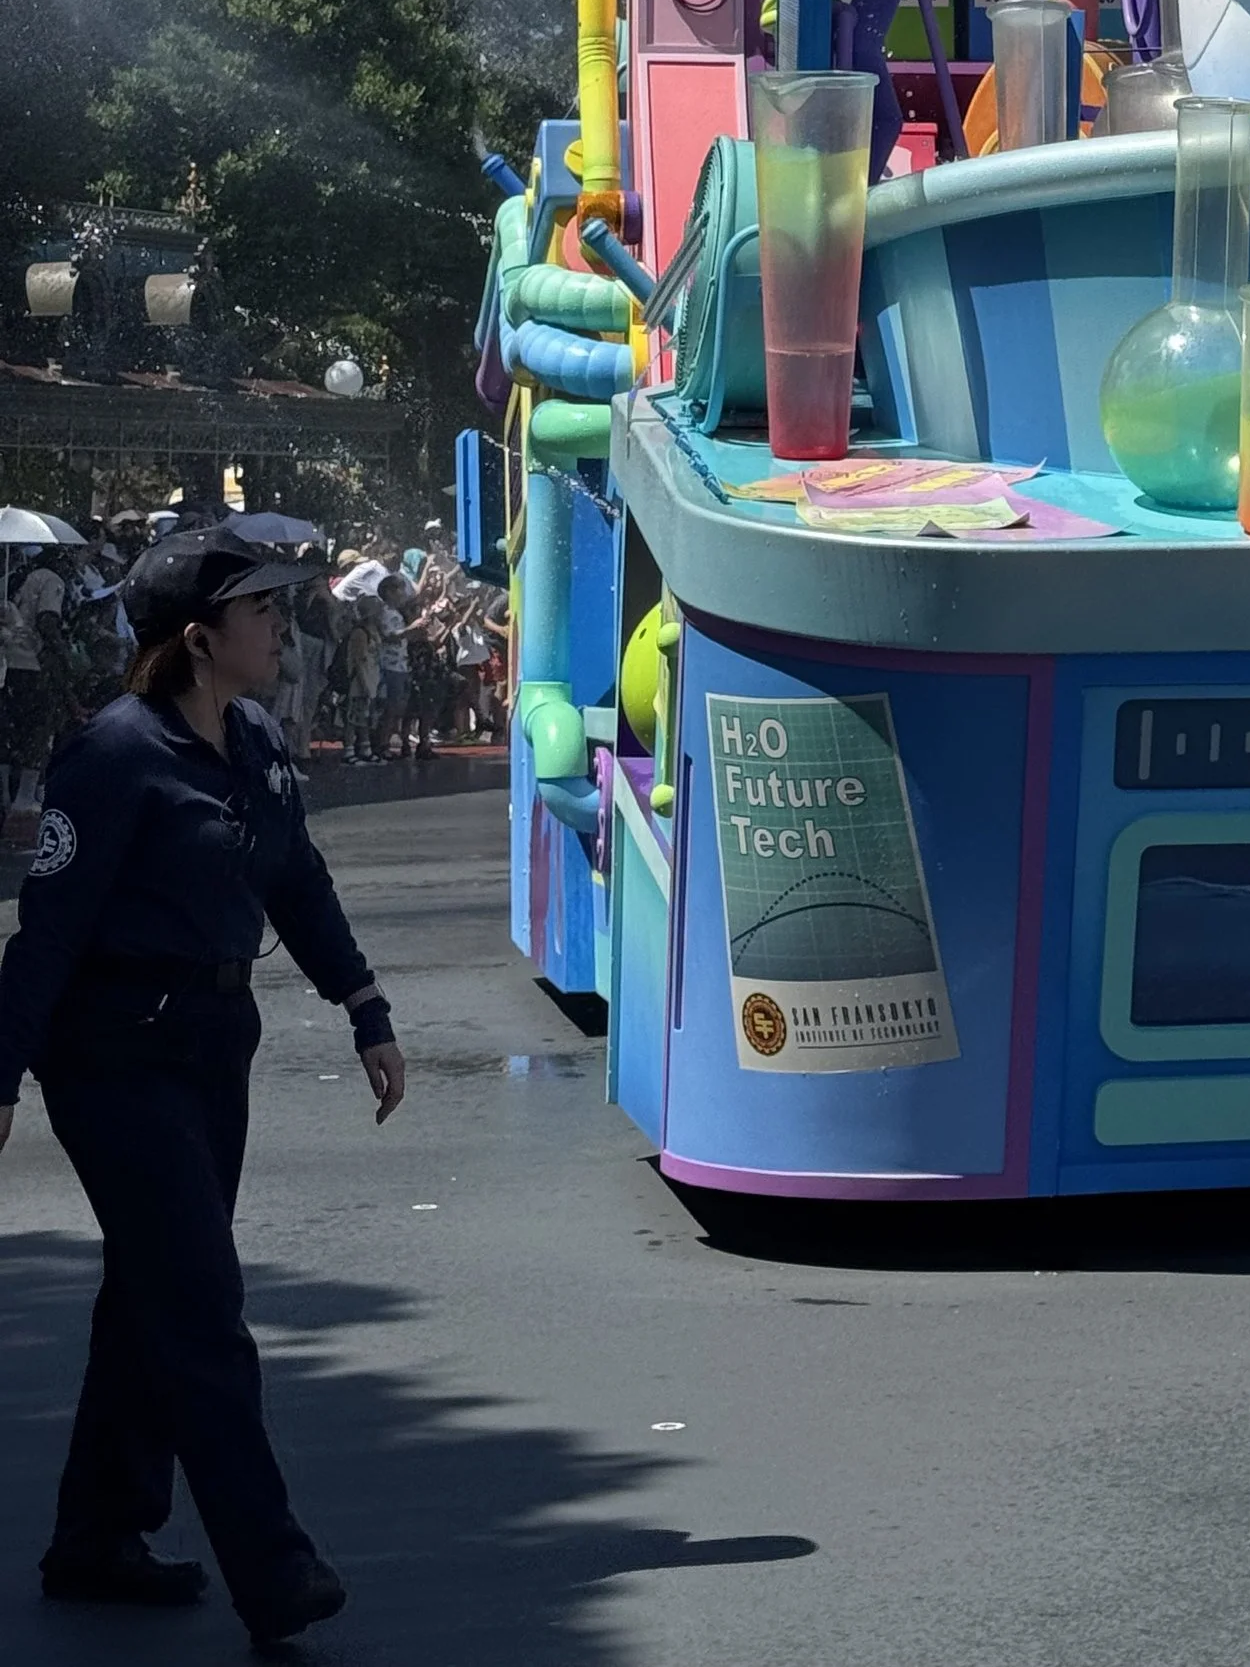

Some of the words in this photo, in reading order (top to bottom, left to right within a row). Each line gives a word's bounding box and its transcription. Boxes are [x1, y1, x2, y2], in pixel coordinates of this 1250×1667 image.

[719, 714, 789, 759] H2O
[725, 764, 868, 809] Future
[729, 814, 837, 859] Tech
[791, 1006, 821, 1027] SAN
[831, 997, 937, 1027] FRANSOKYO
